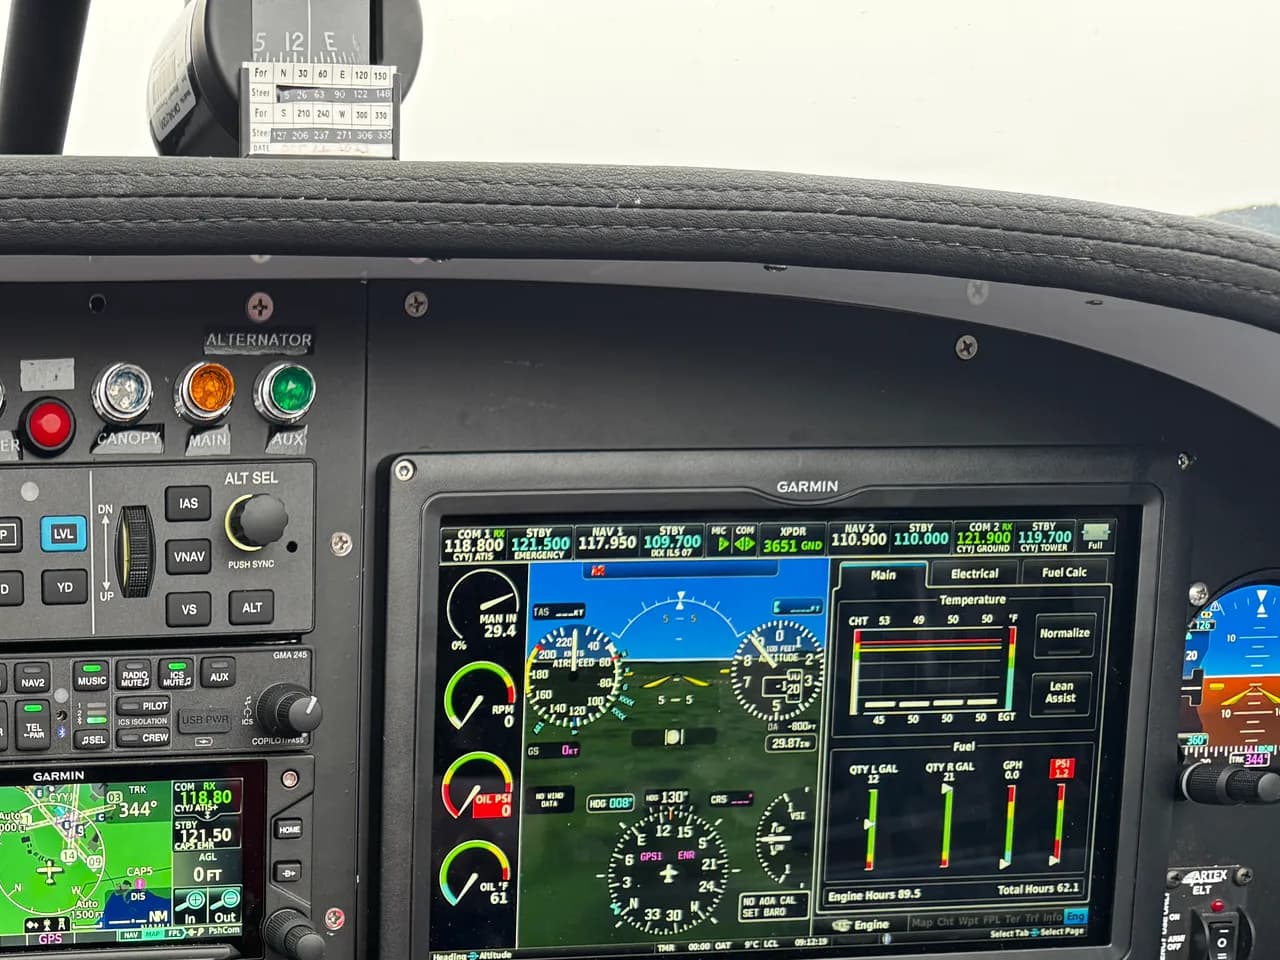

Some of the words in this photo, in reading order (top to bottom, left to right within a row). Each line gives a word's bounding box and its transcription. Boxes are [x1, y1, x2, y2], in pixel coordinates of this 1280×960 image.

[255, 68, 267, 78] For
[281, 69, 286, 77] N
[298, 69, 308, 78] 30
[318, 69, 327, 78] 60
[340, 70, 344, 78] E
[356, 71, 368, 79] 120
[255, 108, 267, 117] For
[282, 109, 286, 117] S
[340, 110, 345, 118] W
[206, 333, 312, 348] ALTERNATOR
[97, 431, 161, 447] CANOPY
[189, 432, 227, 447] MAIN
[272, 432, 304, 447] AUX
[225, 472, 249, 484] ALT
[253, 472, 279, 484] SEL
[777, 481, 838, 493] GARMIN
[179, 497, 198, 510] IAS
[98, 504, 113, 515] DN
[54, 528, 74, 540] LVL
[957, 532, 1011, 544] 121.900
[1018, 531, 1072, 544] 119.700
[174, 551, 205, 563] VNAV
[228, 560, 251, 569] PUSH
[252, 559, 275, 569] SYNC
[871, 570, 896, 581] Main
[951, 568, 998, 580] Electrical
[1042, 567, 1064, 578] Fuel
[1066, 567, 1087, 578] Calc
[58, 582, 73, 593] YD
[100, 591, 114, 602] UP
[940, 595, 1006, 606] Temperature
[182, 604, 197, 616] VS
[242, 602, 262, 614] ALT
[1040, 628, 1090, 639] Normalize
[273, 652, 291, 660] GMA
[293, 651, 307, 659] 245
[78, 676, 107, 686] MUSIC
[122, 672, 149, 681] RADIO
[210, 672, 229, 683] AUX
[21, 678, 45, 689] NAV2
[143, 702, 168, 711] PILOT
[25, 723, 42, 734] TEL
[142, 733, 168, 743] CREW
[33, 770, 85, 782] GARMIN
[128, 786, 146, 795] TRK
[180, 790, 232, 805] 118.80
[120, 800, 158, 817] 344°
[180, 828, 232, 843] 121.50
[280, 826, 300, 835] HOME
[199, 853, 217, 862] AGL
[828, 891, 864, 903] Engine
[865, 889, 896, 900] Hours
[897, 888, 921, 899] 89.5
[1192, 885, 1212, 895] ELT
[184, 914, 196, 925] In
[214, 912, 236, 923] Out
[38, 933, 63, 945] GPS
